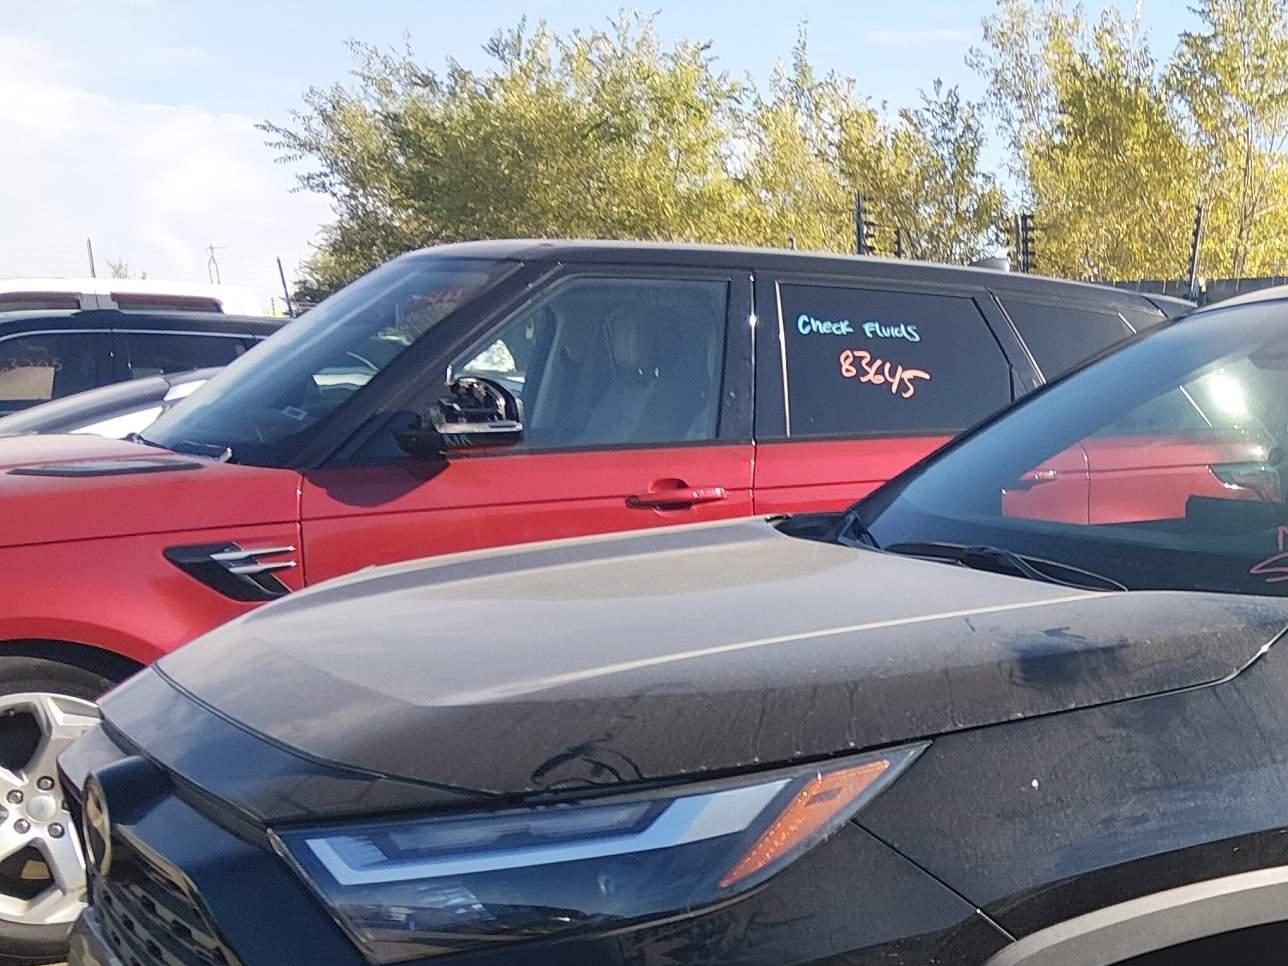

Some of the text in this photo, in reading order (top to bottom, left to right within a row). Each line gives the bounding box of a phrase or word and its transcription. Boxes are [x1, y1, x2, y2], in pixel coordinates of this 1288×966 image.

[797, 314, 921, 342] Check Fluids
[839, 349, 931, 398] 83645
